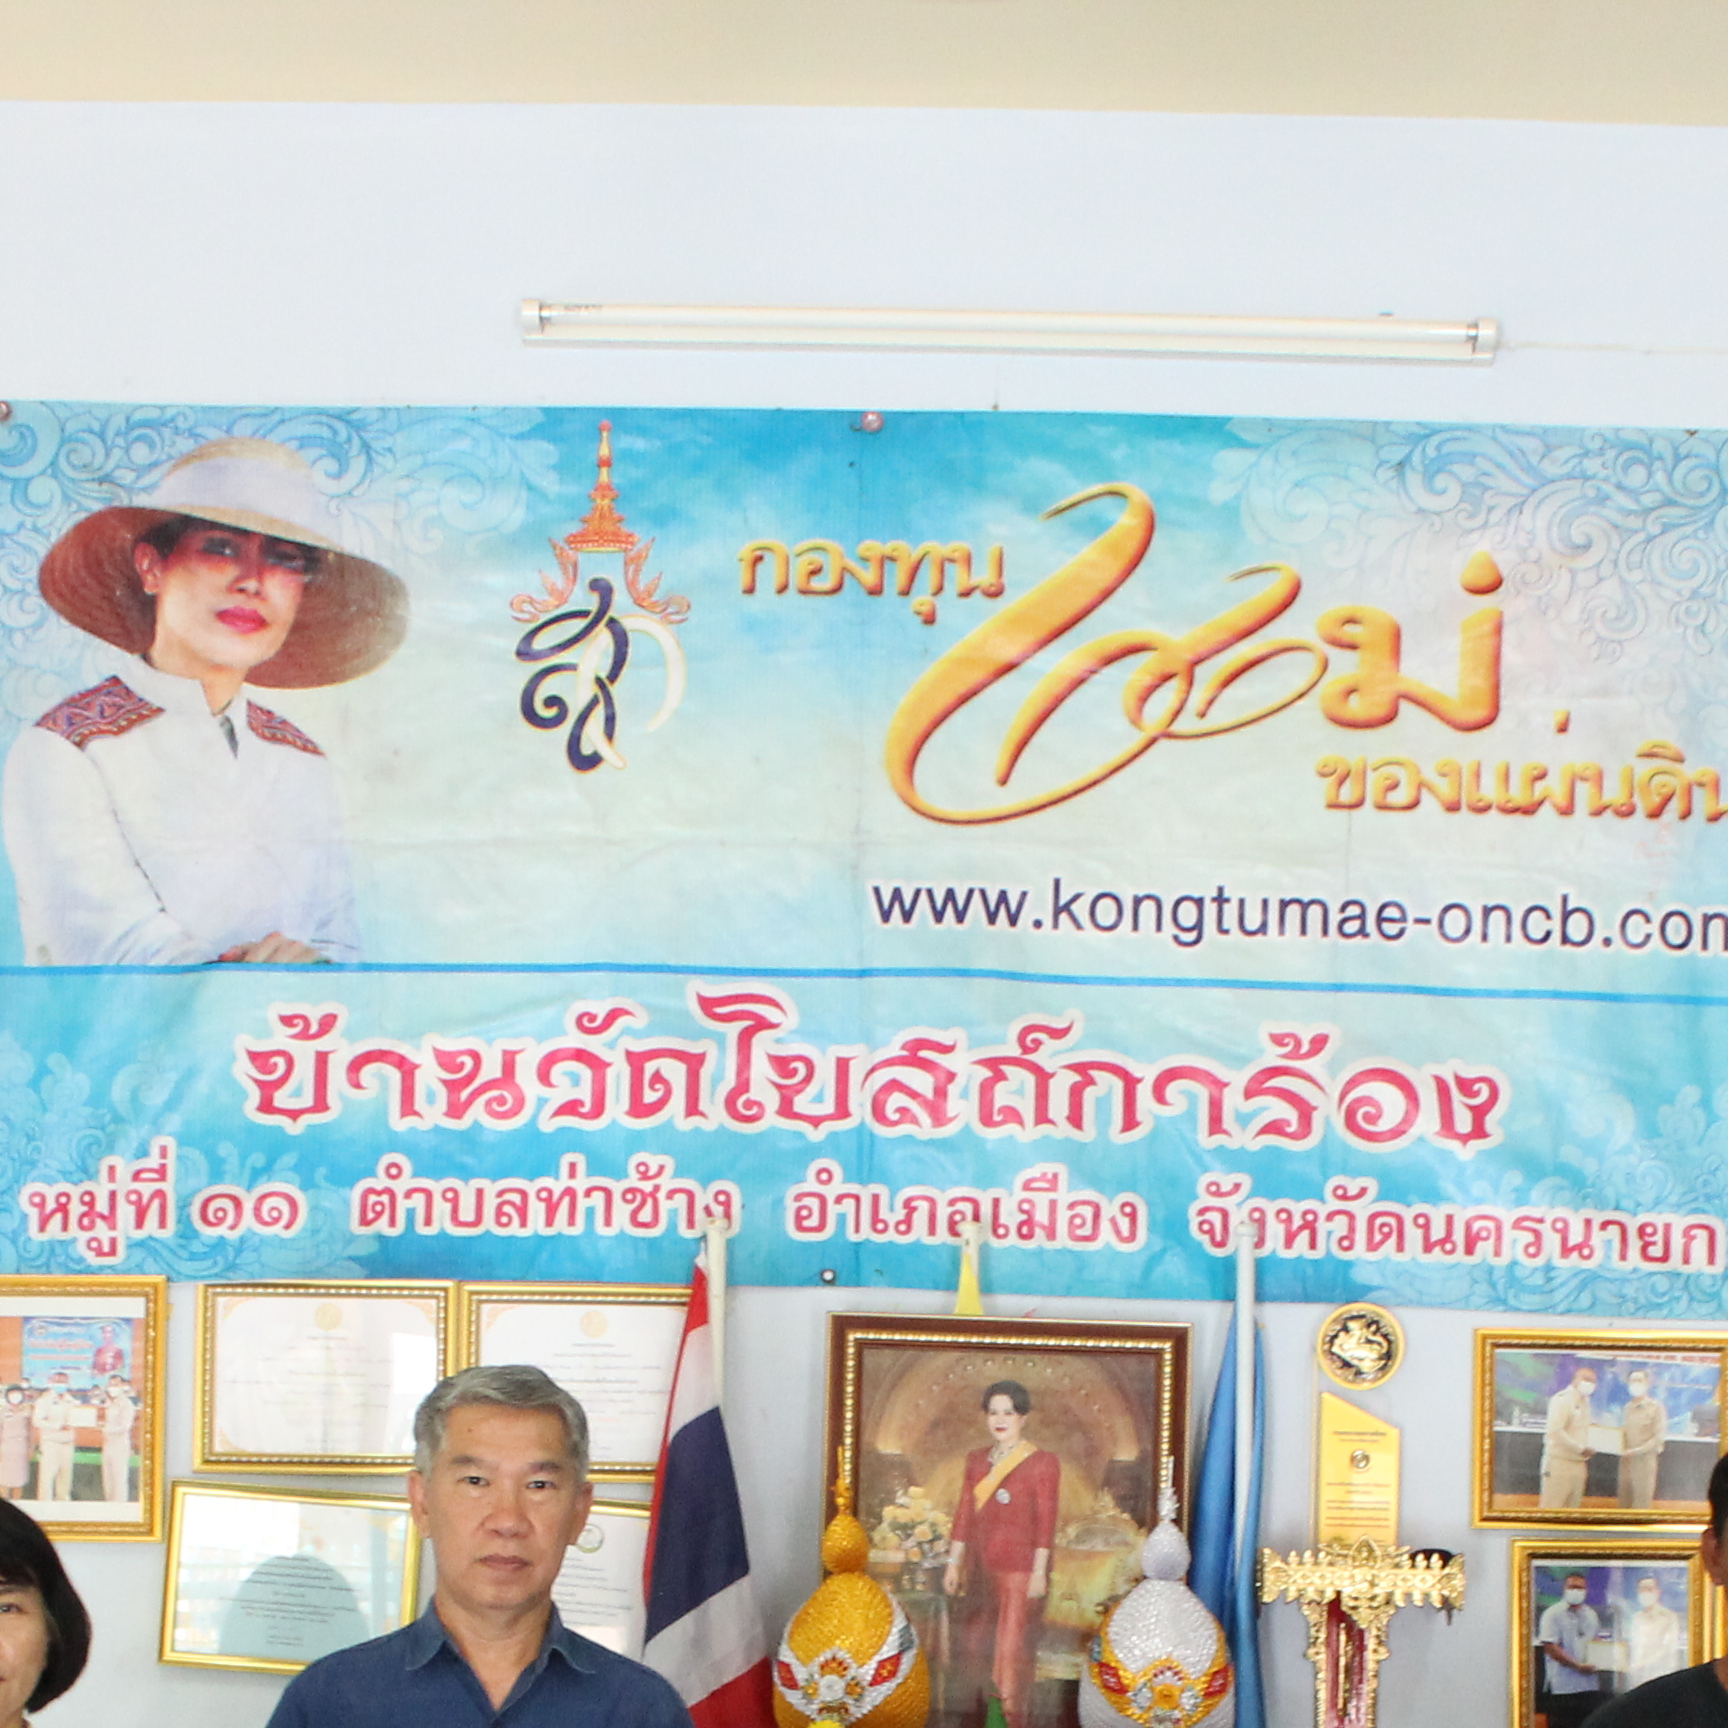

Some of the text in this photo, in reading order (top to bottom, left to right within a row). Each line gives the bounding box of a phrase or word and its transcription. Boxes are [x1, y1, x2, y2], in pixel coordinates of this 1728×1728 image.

[735, 529, 1007, 624] กองทุน
[18, 1141, 1725, 1271] หมู่ที่ ๑๑ ตำบลท่าช้าง อำเภอเมือง จังหวัดนครนายก
